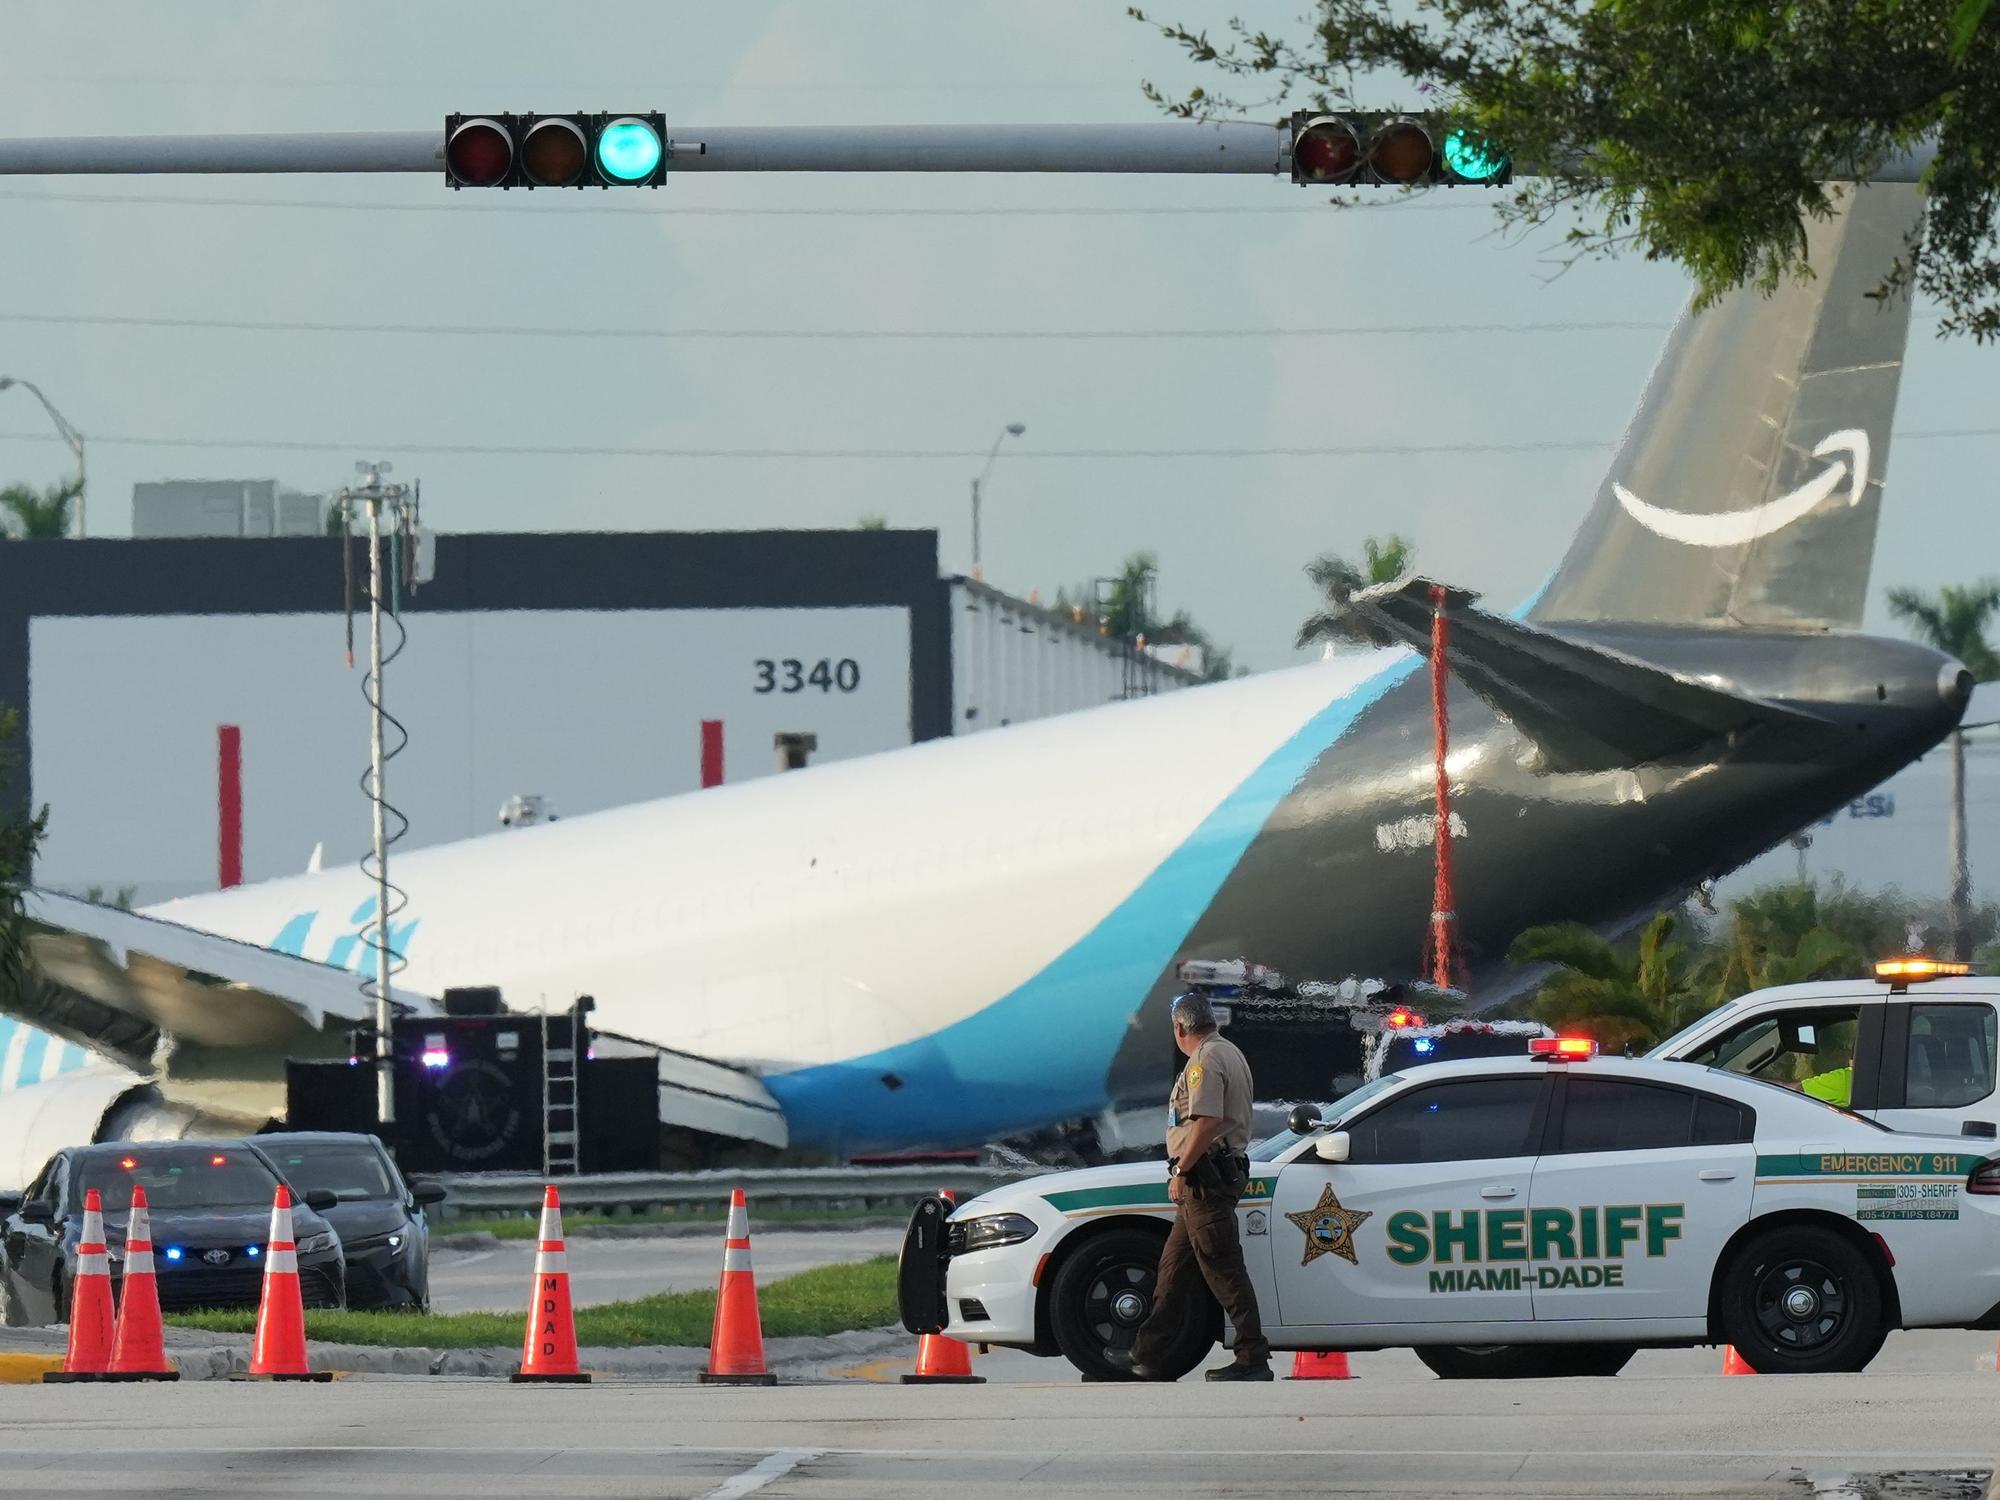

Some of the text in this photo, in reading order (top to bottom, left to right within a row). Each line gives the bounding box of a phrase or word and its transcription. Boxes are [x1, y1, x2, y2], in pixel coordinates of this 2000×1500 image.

[753, 658, 861, 693] 3340
[1820, 1155, 1958, 1172] EMERGENCY 911
[1860, 1210, 1956, 1219] 305-471-TIPS (8477)
[1385, 1203, 1685, 1266] SHERIFF
[1428, 1264, 1625, 1293] MIAMI-DADE
[543, 1279, 558, 1356] MDAD
